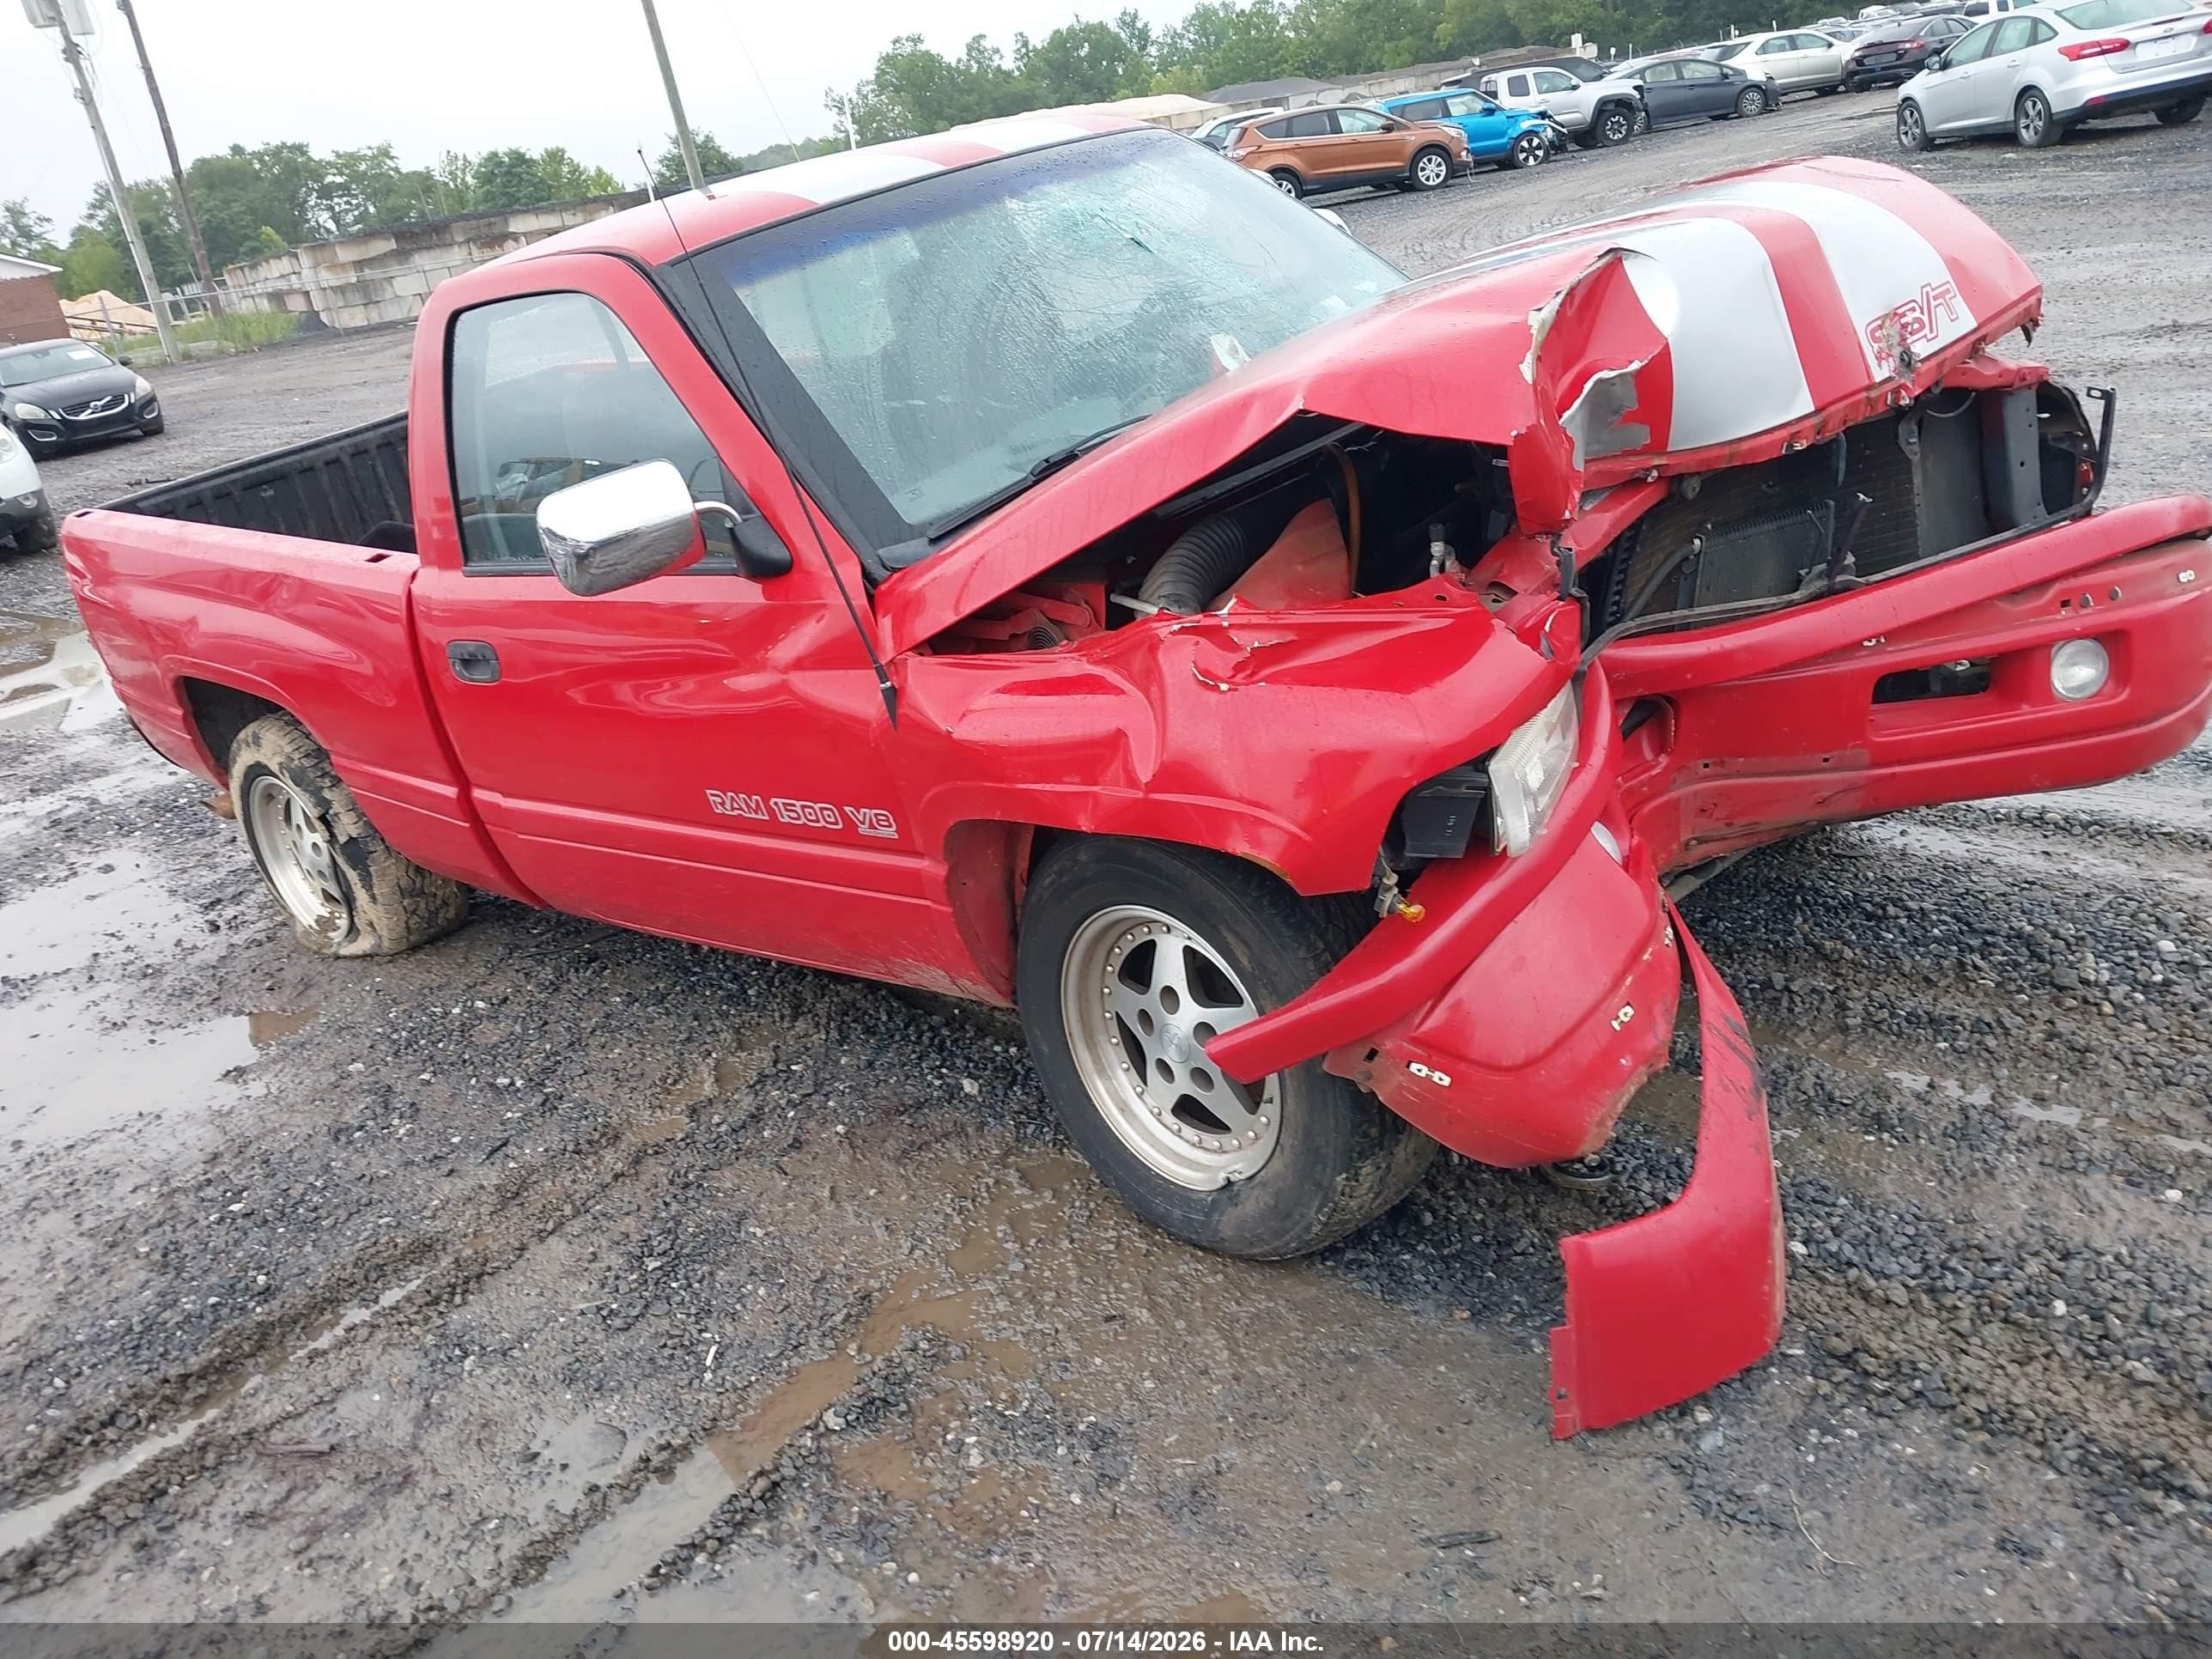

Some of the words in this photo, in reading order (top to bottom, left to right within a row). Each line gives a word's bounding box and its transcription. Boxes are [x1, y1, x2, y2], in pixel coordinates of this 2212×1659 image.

[705, 789, 769, 820] RAM
[769, 797, 843, 830] 1500
[843, 805, 897, 832] V8
